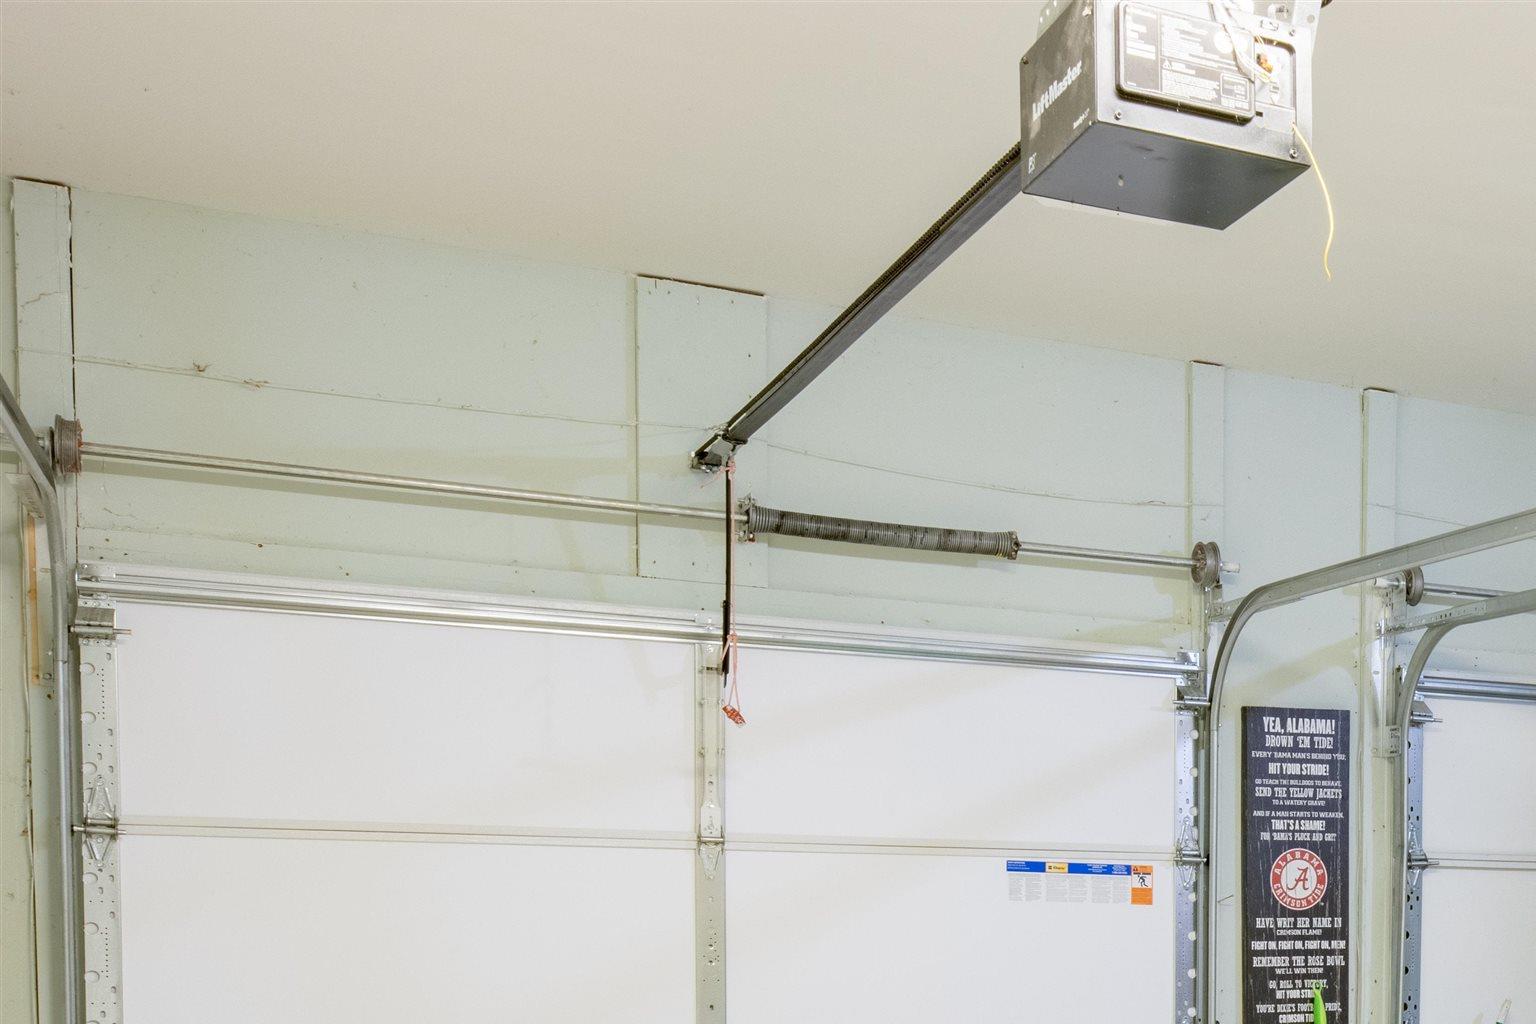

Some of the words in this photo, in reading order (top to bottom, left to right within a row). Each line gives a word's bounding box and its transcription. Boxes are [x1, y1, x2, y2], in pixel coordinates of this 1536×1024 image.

[1263, 717, 1285, 734] YEA,
[1286, 718, 1335, 734] ALABAMA!
[1265, 735, 1294, 747] DROWN
[1252, 750, 1272, 758] EVERY
[1268, 762, 1281, 775] HIT
[1282, 763, 1301, 775] YOUR
[1302, 763, 1330, 776] STRIDE!
[1255, 787, 1272, 797] SEND
[1274, 787, 1287, 797] THE
[1289, 787, 1314, 798] YELLOW
[1316, 788, 1342, 800] JACKETS
[1271, 819, 1295, 830] THAT'S
[1295, 820, 1299, 830] A
[1300, 820, 1326, 831] SHAME!
[1312, 833, 1323, 841] AND
[1274, 851, 1323, 875] ALABAMA
[1274, 883, 1307, 907] CRIMSON
[1308, 884, 1324, 903] TIDE
[1256, 917, 1274, 928] HAVE
[1276, 917, 1294, 928] WRIT
[1296, 917, 1310, 928] HER
[1312, 917, 1332, 927] NAME
[1334, 917, 1342, 927] IN
[1251, 941, 1267, 950] FIGHT
[1278, 941, 1294, 950] FIGHT
[1305, 940, 1320, 950] FIGHT
[1253, 956, 1290, 967] REMEMBER
[1292, 956, 1305, 966] THE
[1307, 955, 1324, 966] ROSE
[1326, 955, 1345, 966] BOWL
[1280, 980, 1293, 989] ROLL
[1295, 980, 1303, 988] TO
[1276, 990, 1285, 999] HIT
[1286, 990, 1300, 999] YOUR
[1297, 1003, 1314, 1011] FOOTB
[1279, 1014, 1305, 1023] CRIMSON
[1305, 1014, 1314, 1022] TID
